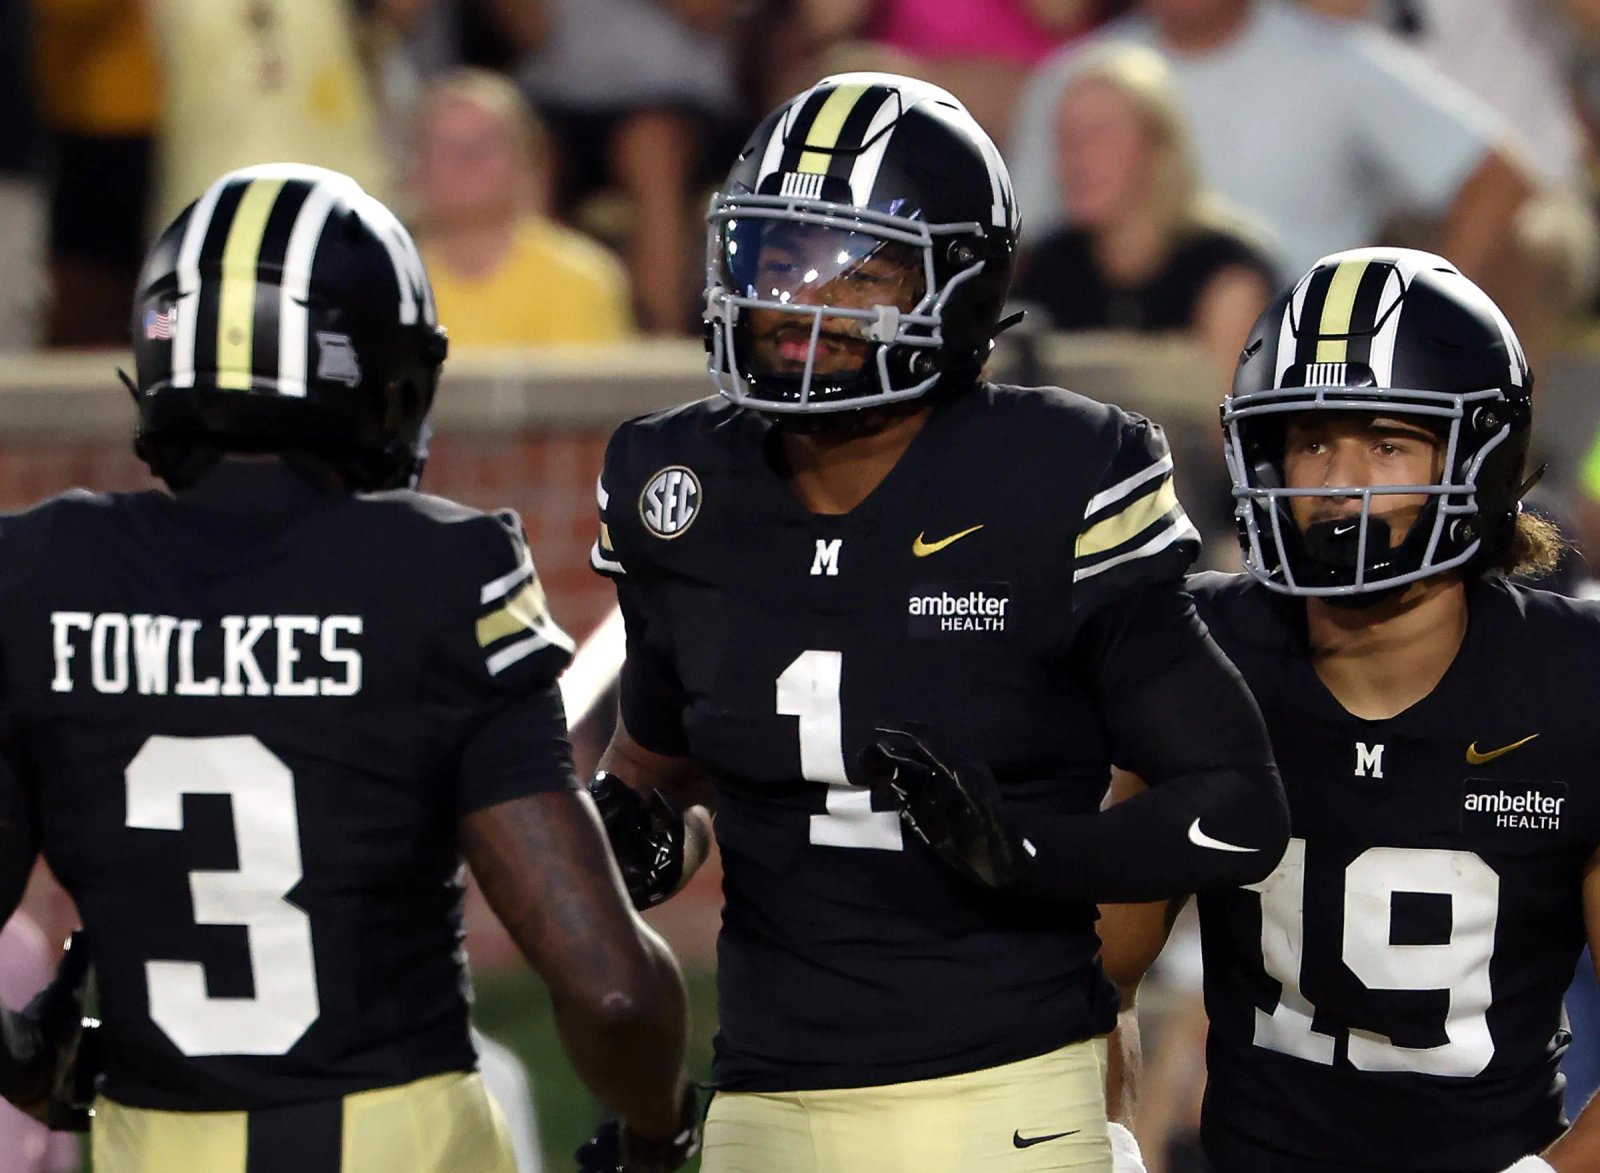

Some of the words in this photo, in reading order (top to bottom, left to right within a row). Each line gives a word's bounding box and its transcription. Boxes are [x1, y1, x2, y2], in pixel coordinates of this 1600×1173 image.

[645, 471, 697, 533] SEC
[810, 539, 842, 576] M
[908, 591, 1009, 617] ambetter
[941, 617, 1006, 632] HEALTH
[50, 611, 363, 697] FOWLKES
[775, 650, 904, 851] 1
[1354, 742, 1385, 779] M
[1464, 790, 1565, 816] ambetter
[1496, 815, 1561, 830] HEALTH
[125, 735, 320, 1057] 3
[1238, 837, 1500, 1078] 19
